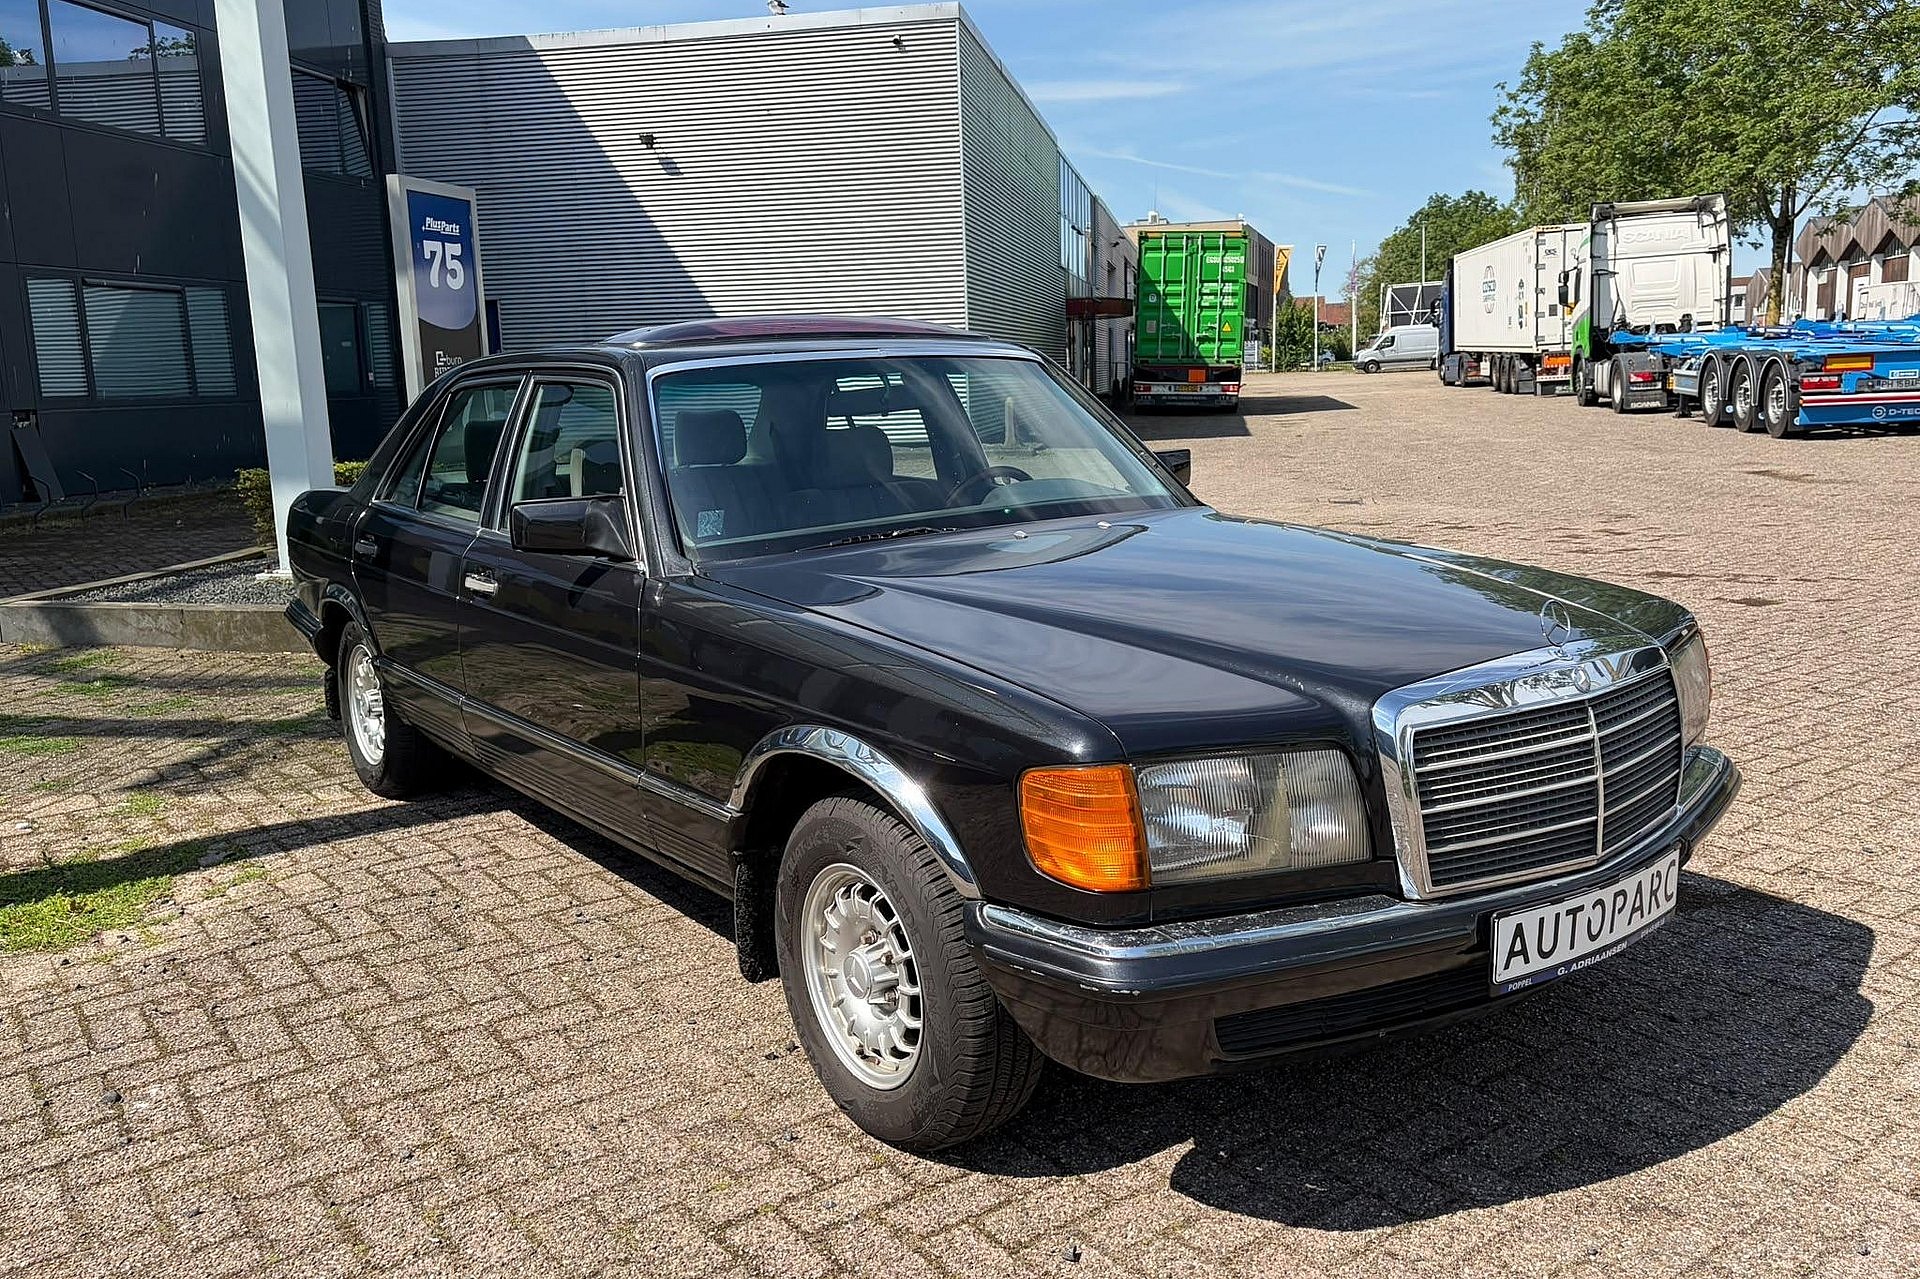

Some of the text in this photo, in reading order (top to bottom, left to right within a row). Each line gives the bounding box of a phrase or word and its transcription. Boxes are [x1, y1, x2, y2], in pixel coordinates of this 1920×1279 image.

[425, 216, 460, 233] PlusParts
[1623, 228, 1689, 244] SCANIA
[423, 240, 465, 291] 75
[1502, 859, 1676, 971] AUTOPARC
[1556, 940, 1628, 977] G. ADRIAANSEN
[1507, 977, 1533, 992] POPPEL
